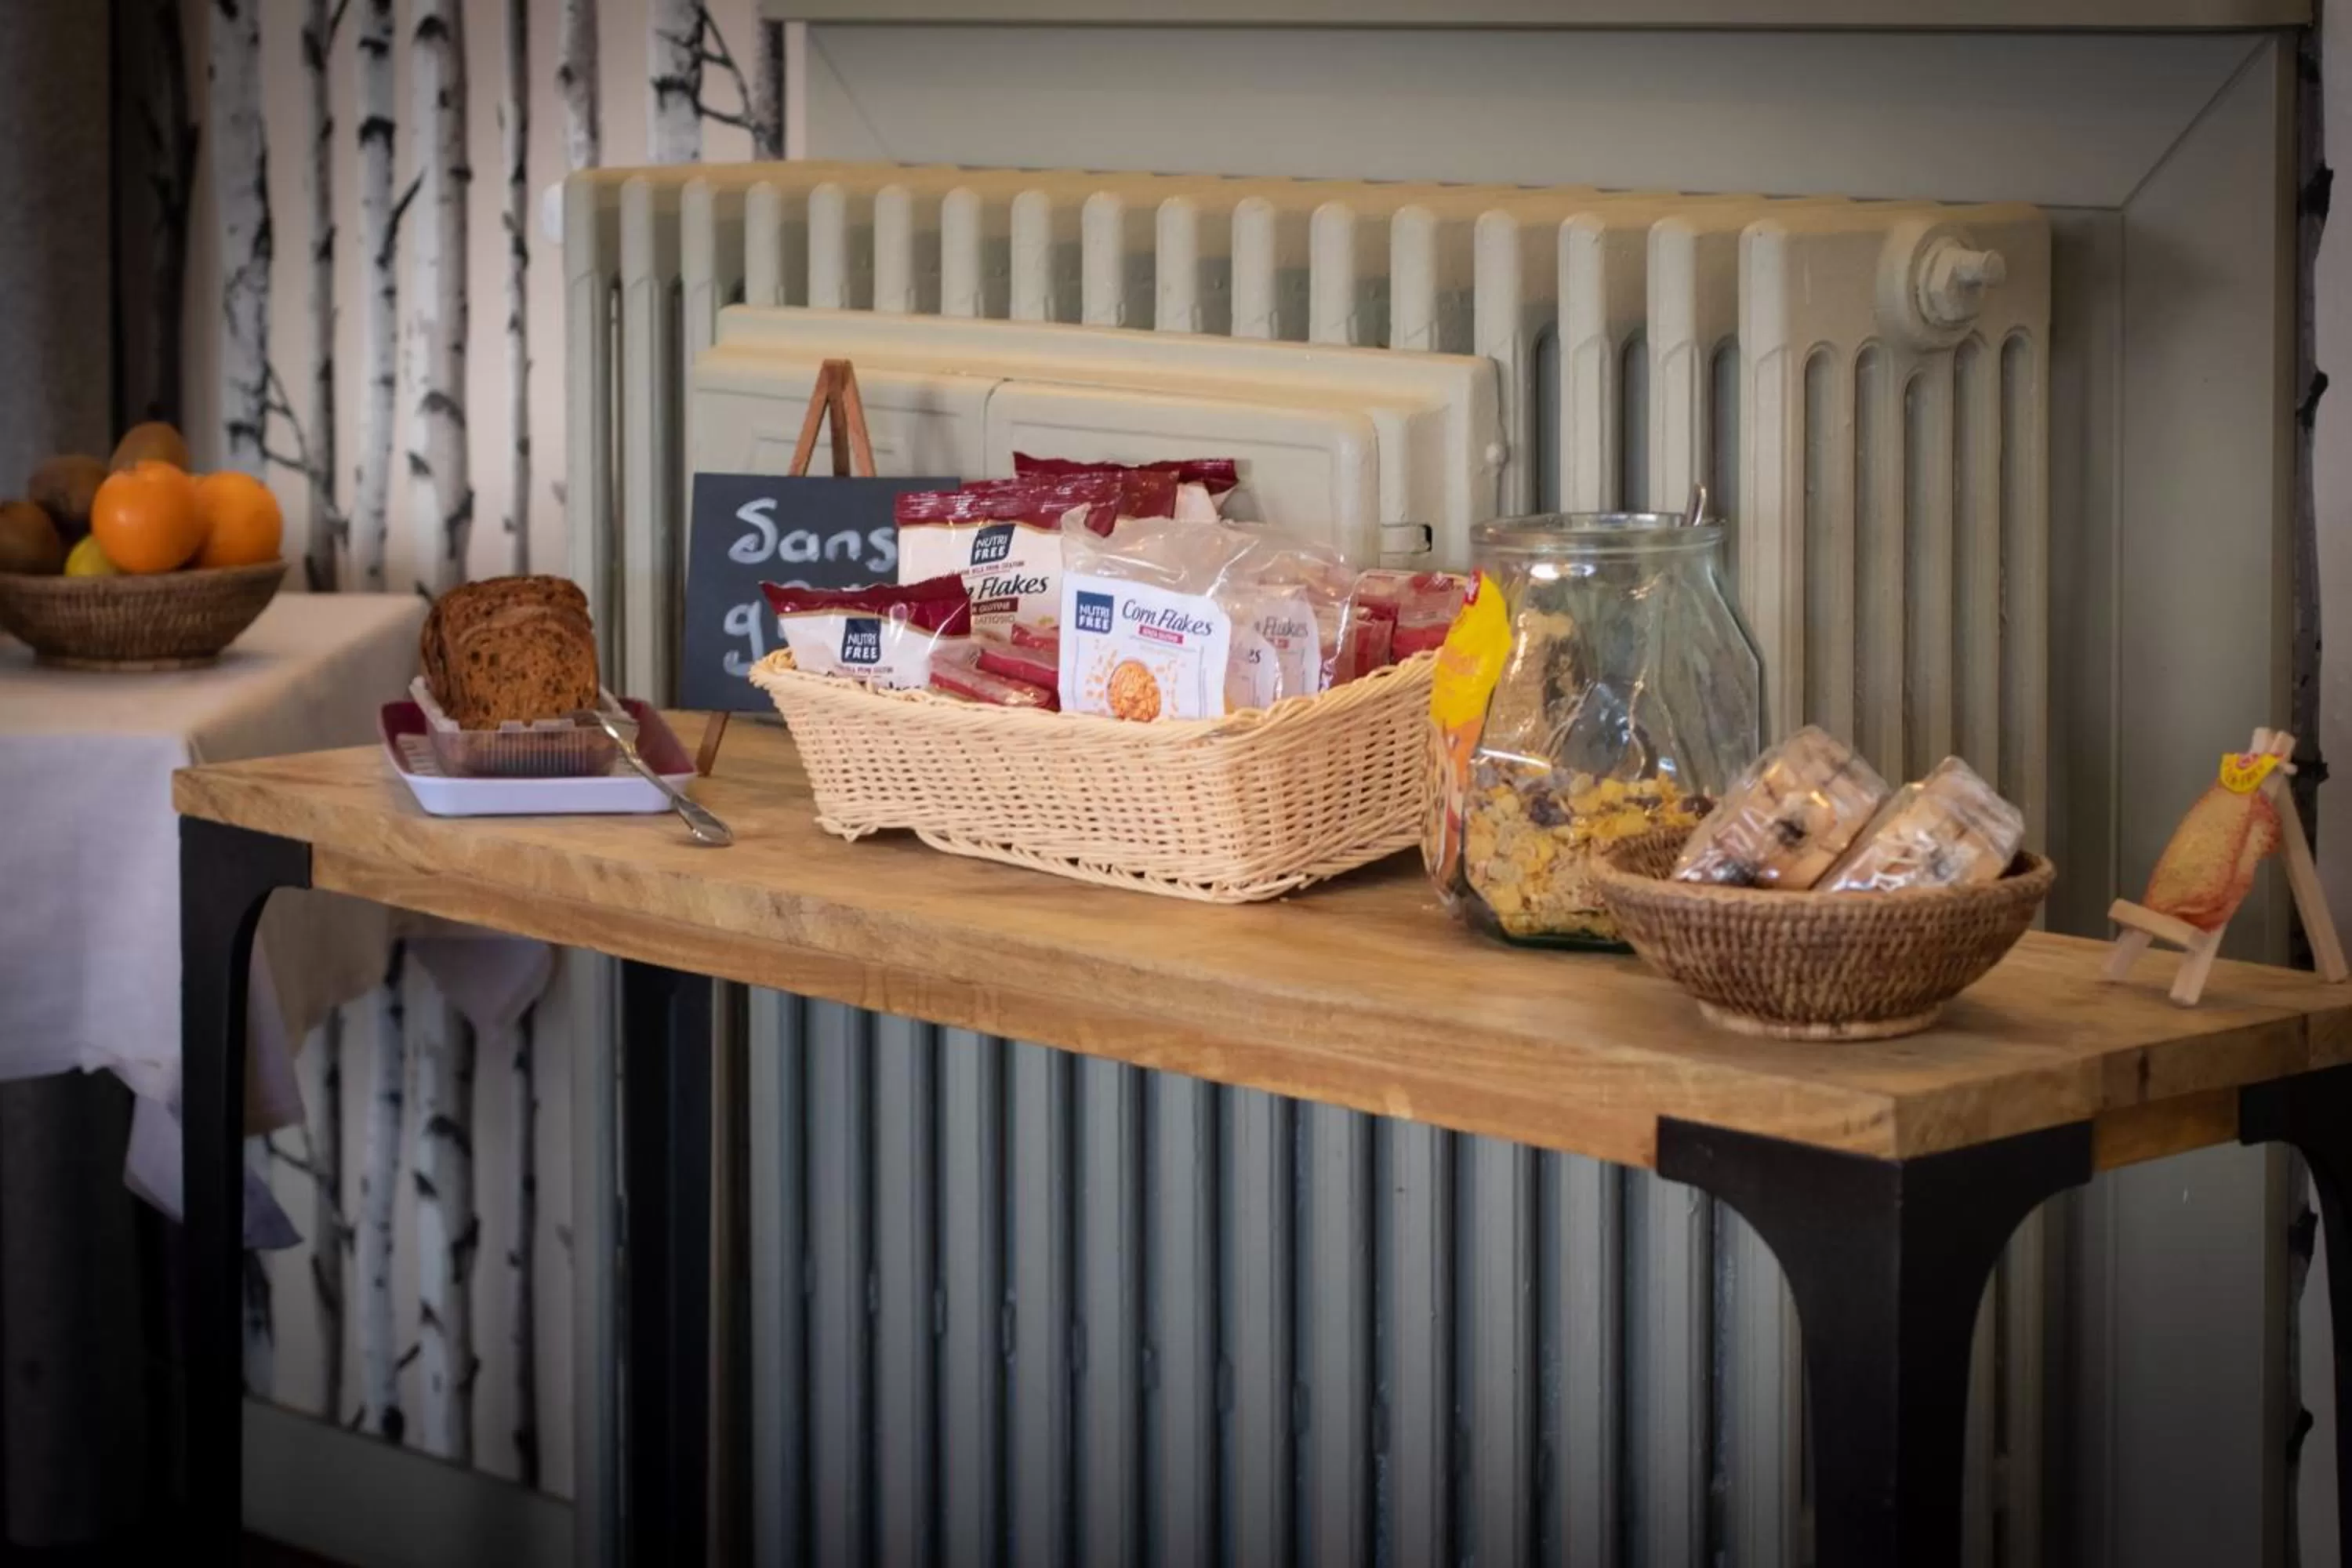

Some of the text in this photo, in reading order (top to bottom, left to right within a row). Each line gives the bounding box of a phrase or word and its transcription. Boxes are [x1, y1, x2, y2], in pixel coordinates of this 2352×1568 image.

[728, 497, 898, 572] Sans
[976, 535, 1008, 548] NUTRI
[975, 546, 1006, 561] FREE
[978, 574, 1049, 600] Flakes
[1079, 604, 1111, 616] NUTRI
[1122, 599, 1156, 625] Corn
[1158, 608, 1214, 636] Flakes
[1079, 615, 1110, 630] FREE
[848, 633, 877, 645] NUTRI
[844, 647, 878, 659] FREE
